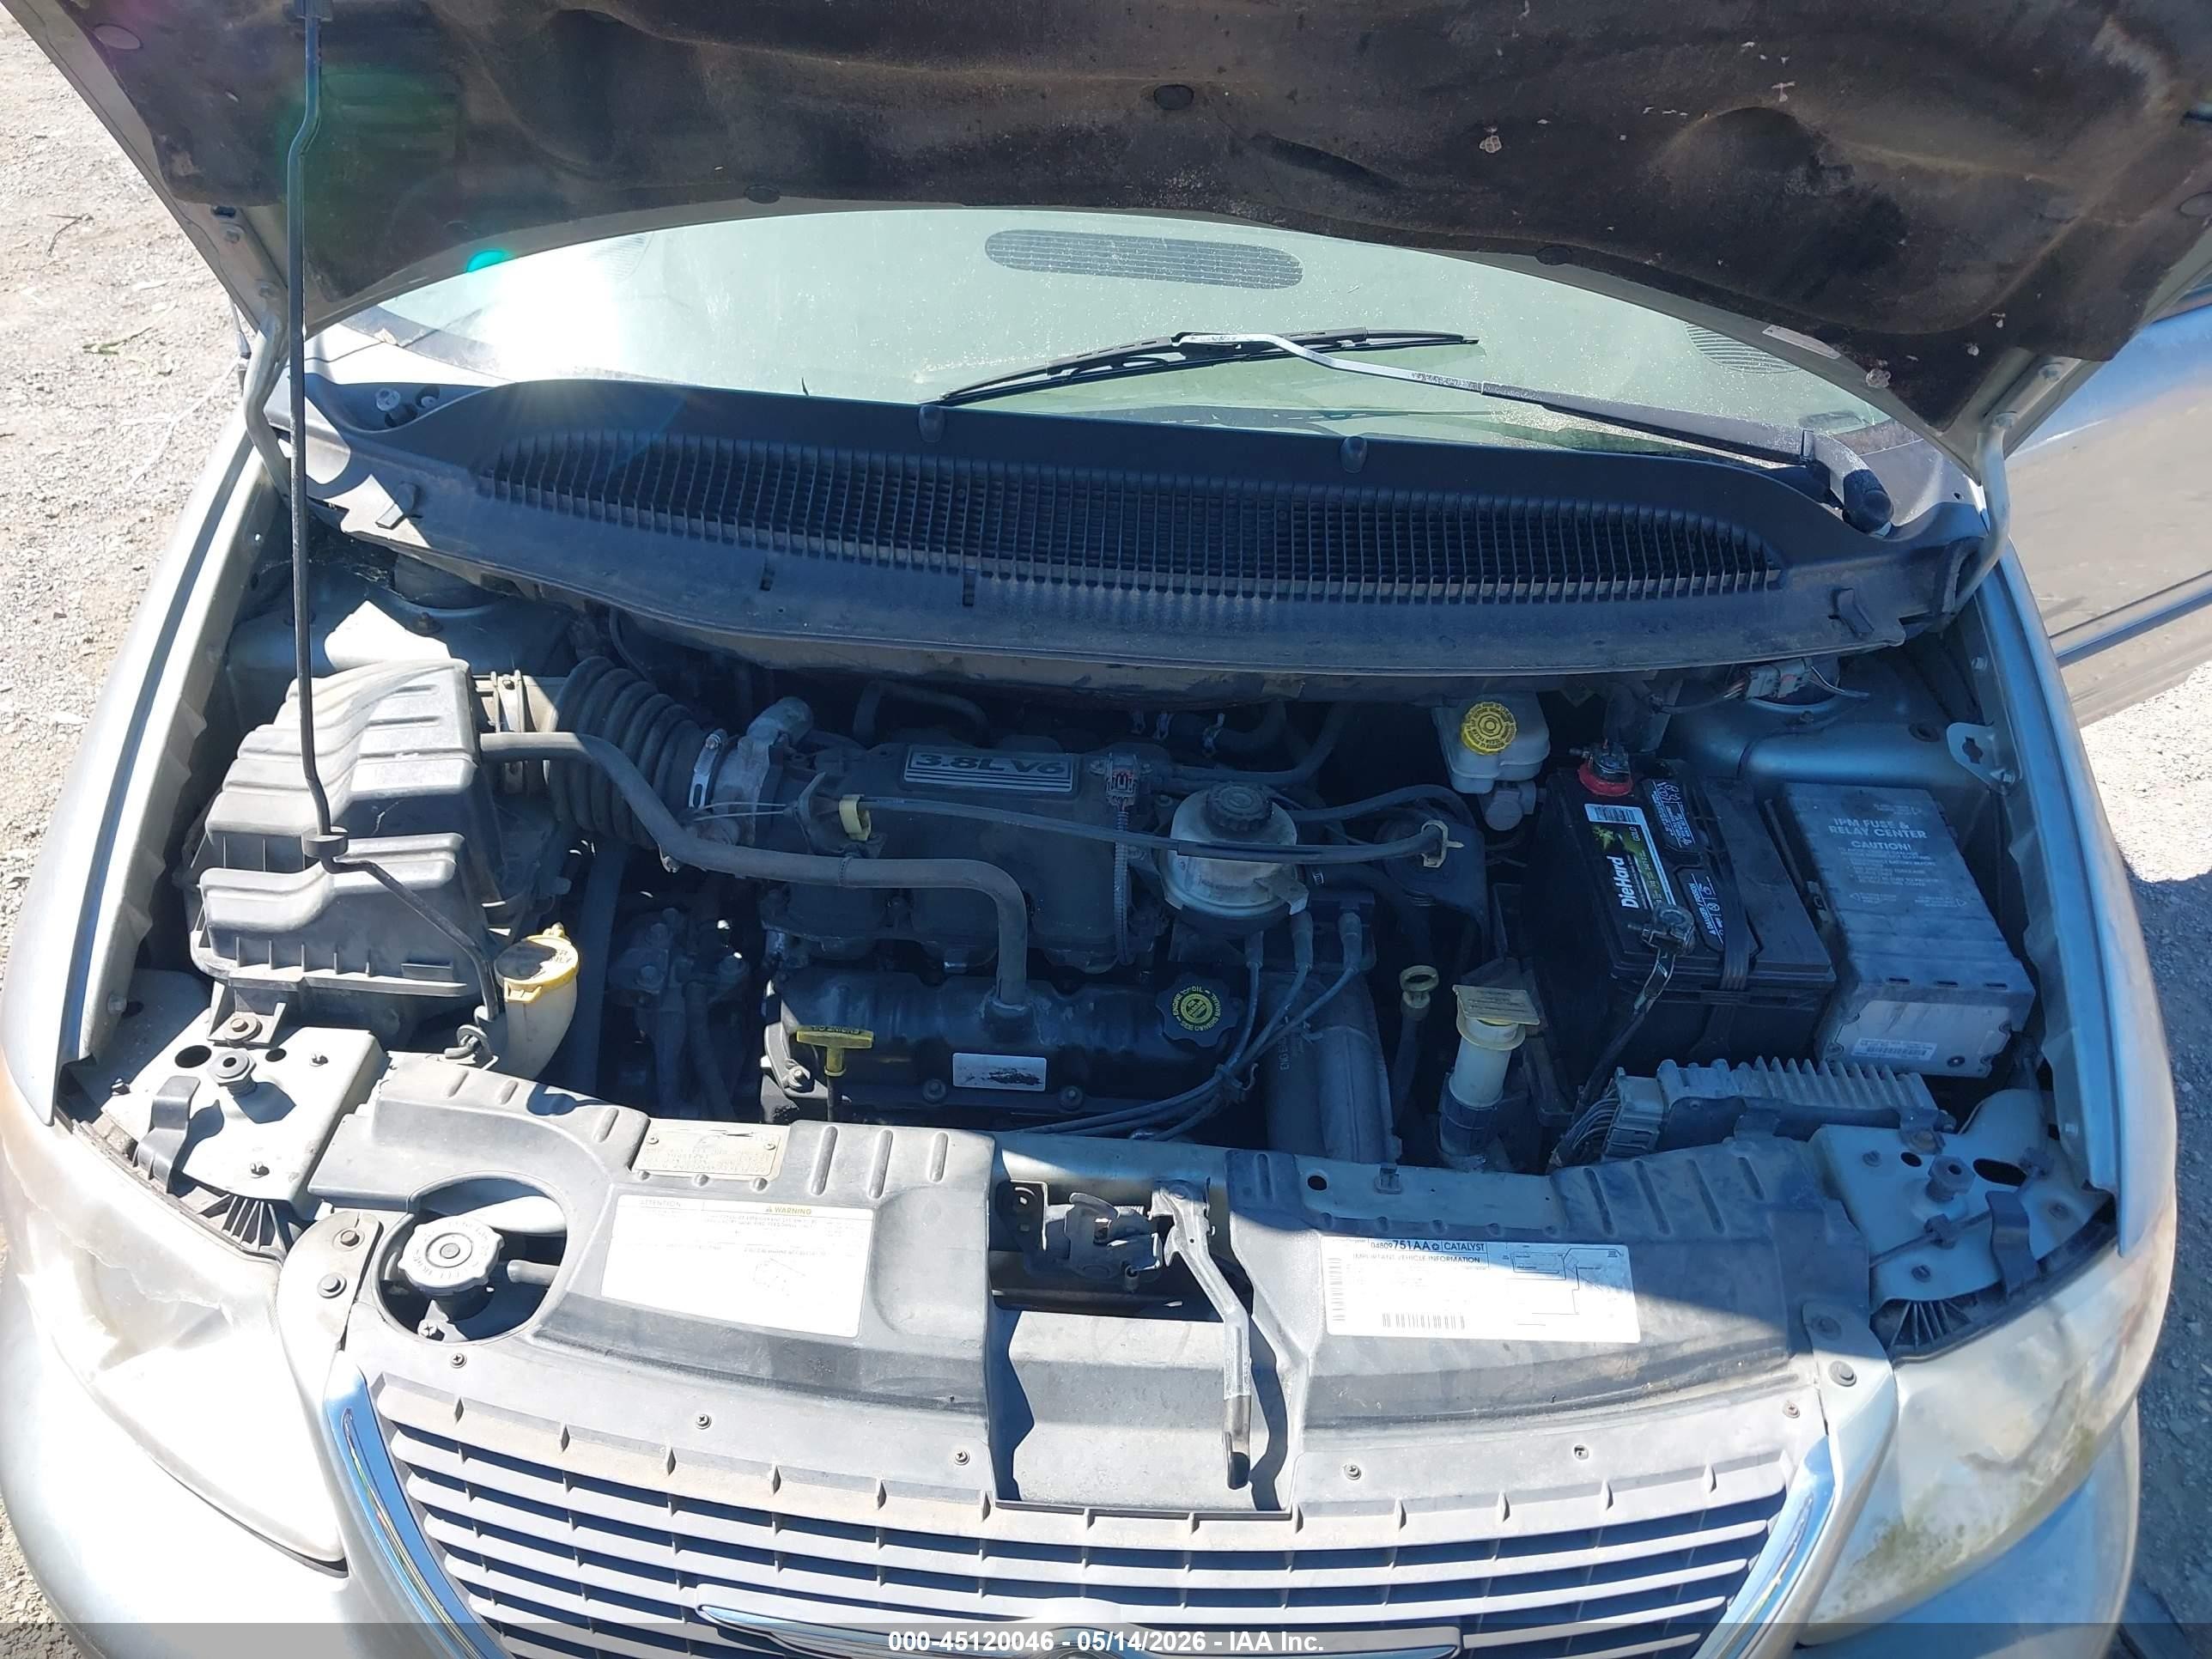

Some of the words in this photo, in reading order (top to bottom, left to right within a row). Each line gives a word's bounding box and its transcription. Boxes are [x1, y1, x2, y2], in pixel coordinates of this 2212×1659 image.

[915, 753, 1004, 772] 3.8L
[1010, 760, 1066, 775] V6
[1833, 817, 1861, 827] IPM
[1863, 819, 1894, 830] FUSE
[1899, 821, 1911, 830] &
[1827, 825, 1869, 836] RELAY
[1874, 829, 1928, 839] CENTER
[1850, 840, 1911, 851] CAUTION!
[1607, 855, 1640, 908] DieHard
[774, 1206, 812, 1217] WARNING
[1443, 1242, 1486, 1252] CATALYST
[1429, 1255, 1480, 1264] INFORMATION
